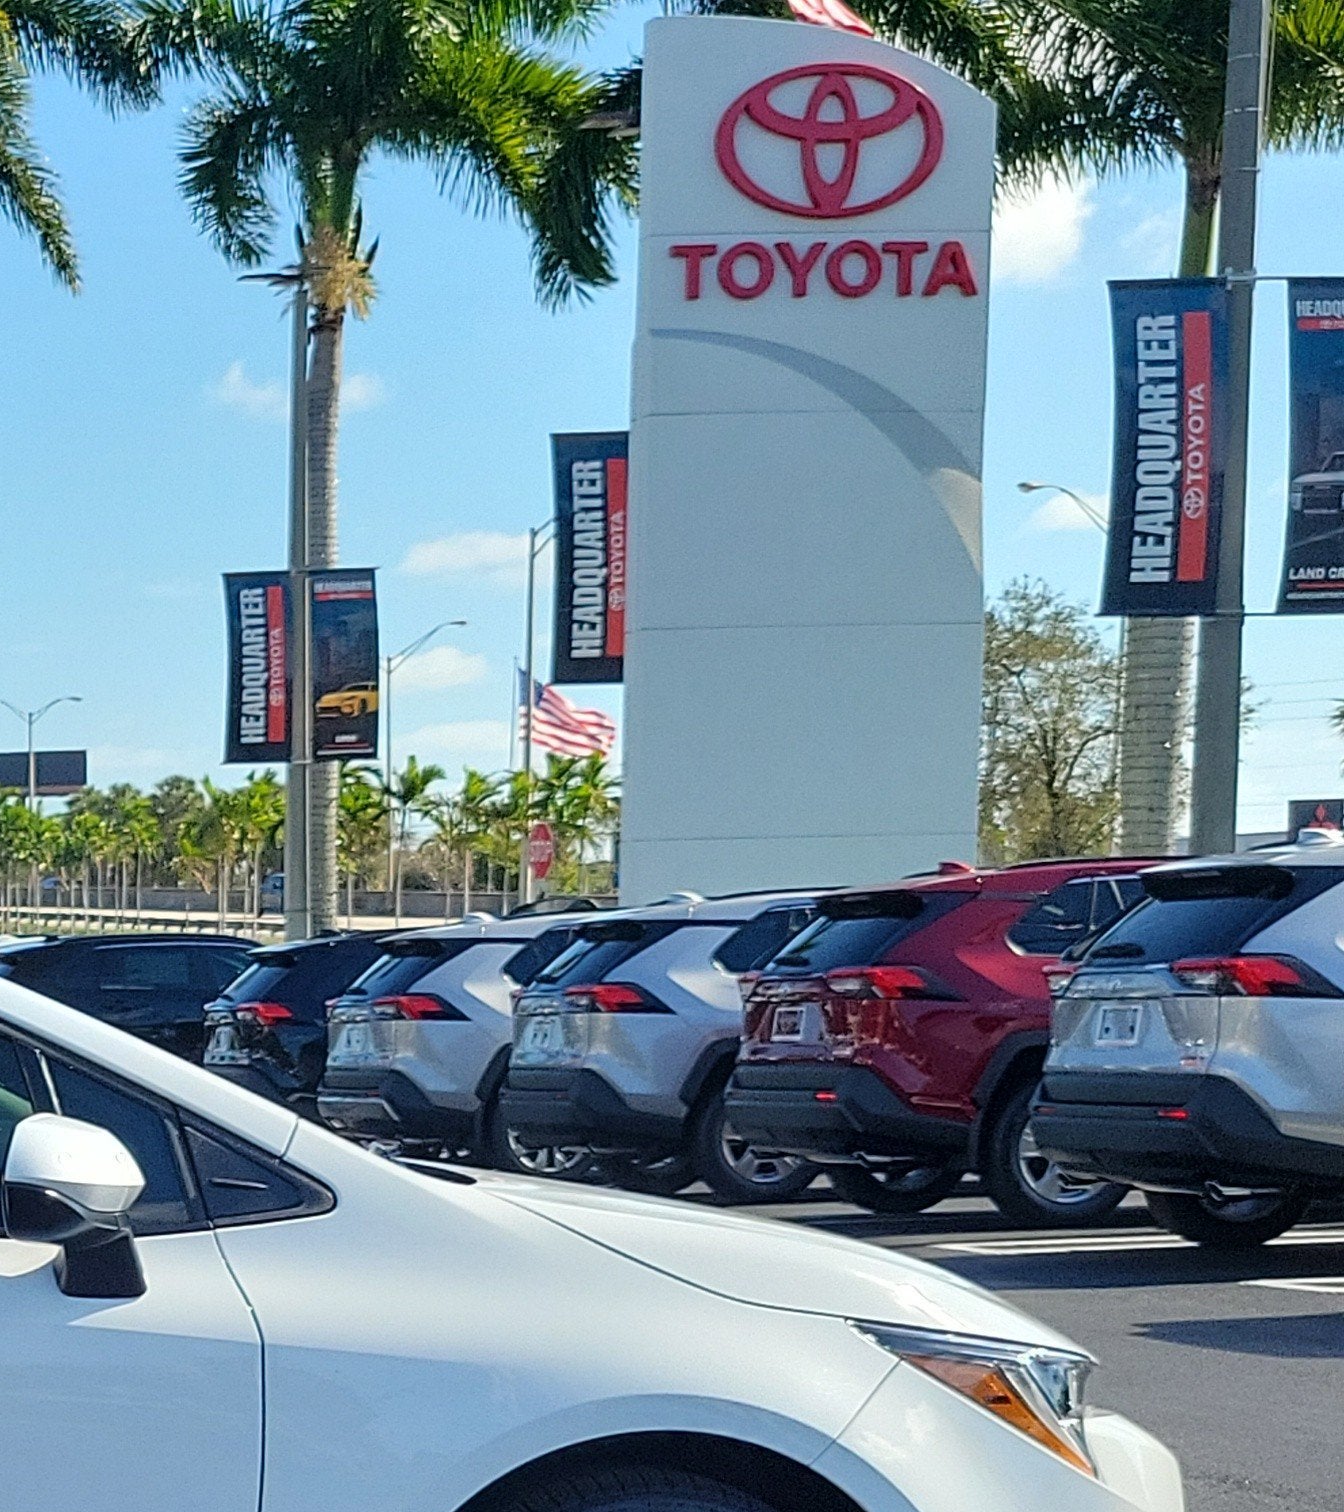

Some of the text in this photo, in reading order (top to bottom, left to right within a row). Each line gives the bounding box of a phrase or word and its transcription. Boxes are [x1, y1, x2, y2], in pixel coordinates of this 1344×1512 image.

[669, 239, 979, 300] TOYOTA
[1129, 314, 1182, 583] HEADQUARTER
[1186, 382, 1206, 485] TOYOTA
[570, 460, 608, 659] HEADQUARTER
[610, 511, 625, 586] TOYOTA
[1289, 567, 1325, 580] LAND
[239, 587, 269, 744] HEADQUARTER
